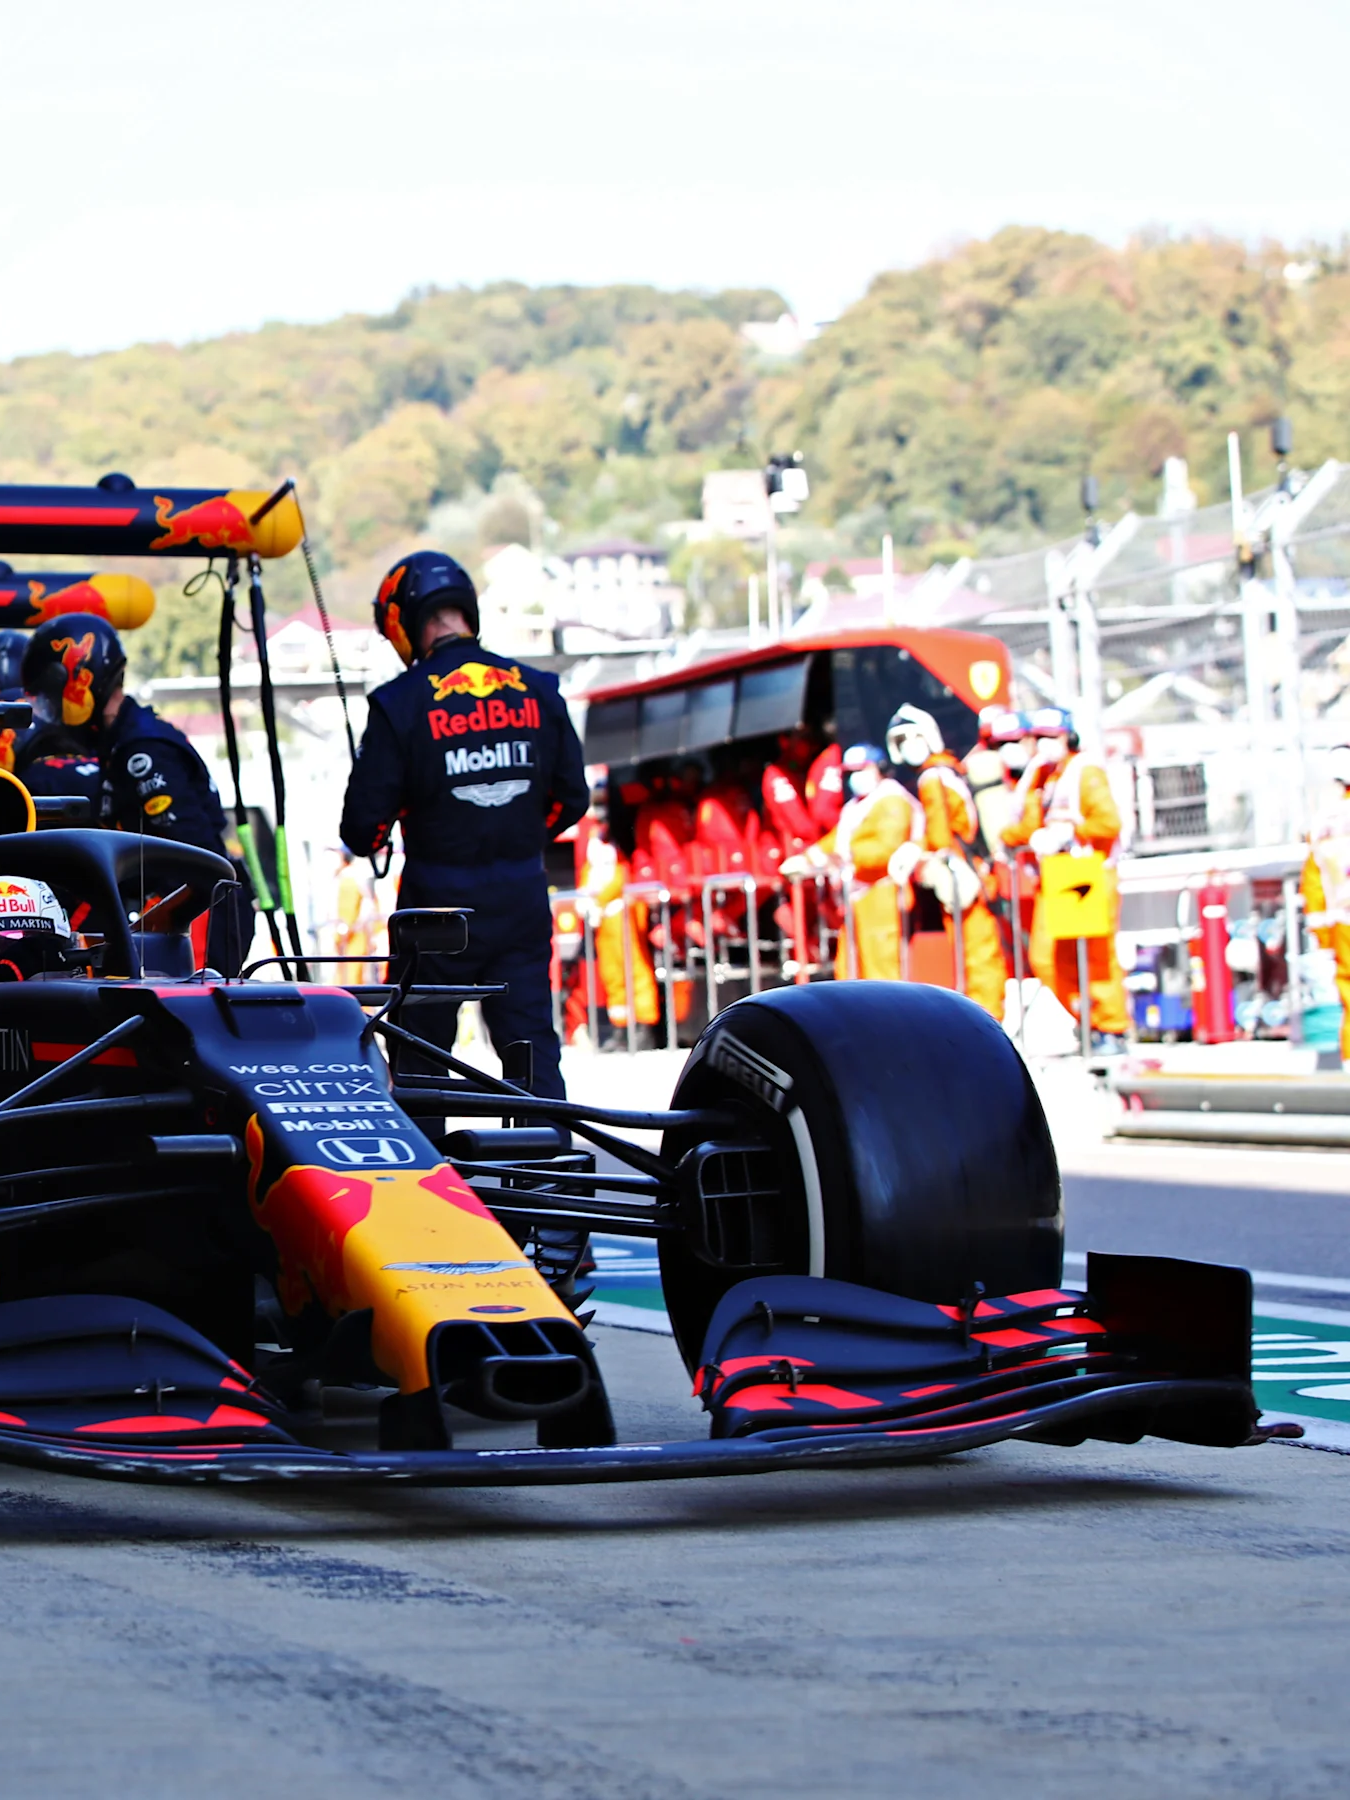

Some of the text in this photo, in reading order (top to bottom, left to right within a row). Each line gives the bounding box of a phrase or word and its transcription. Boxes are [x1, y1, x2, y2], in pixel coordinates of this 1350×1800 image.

[445, 741, 511, 776] Mobil
[9, 918, 52, 930] MARTIN
[229, 1063, 374, 1075] W66.COM
[707, 1028, 794, 1113] PIRELLI
[266, 1101, 396, 1114] PIRELLI
[280, 1118, 376, 1132] Mobil
